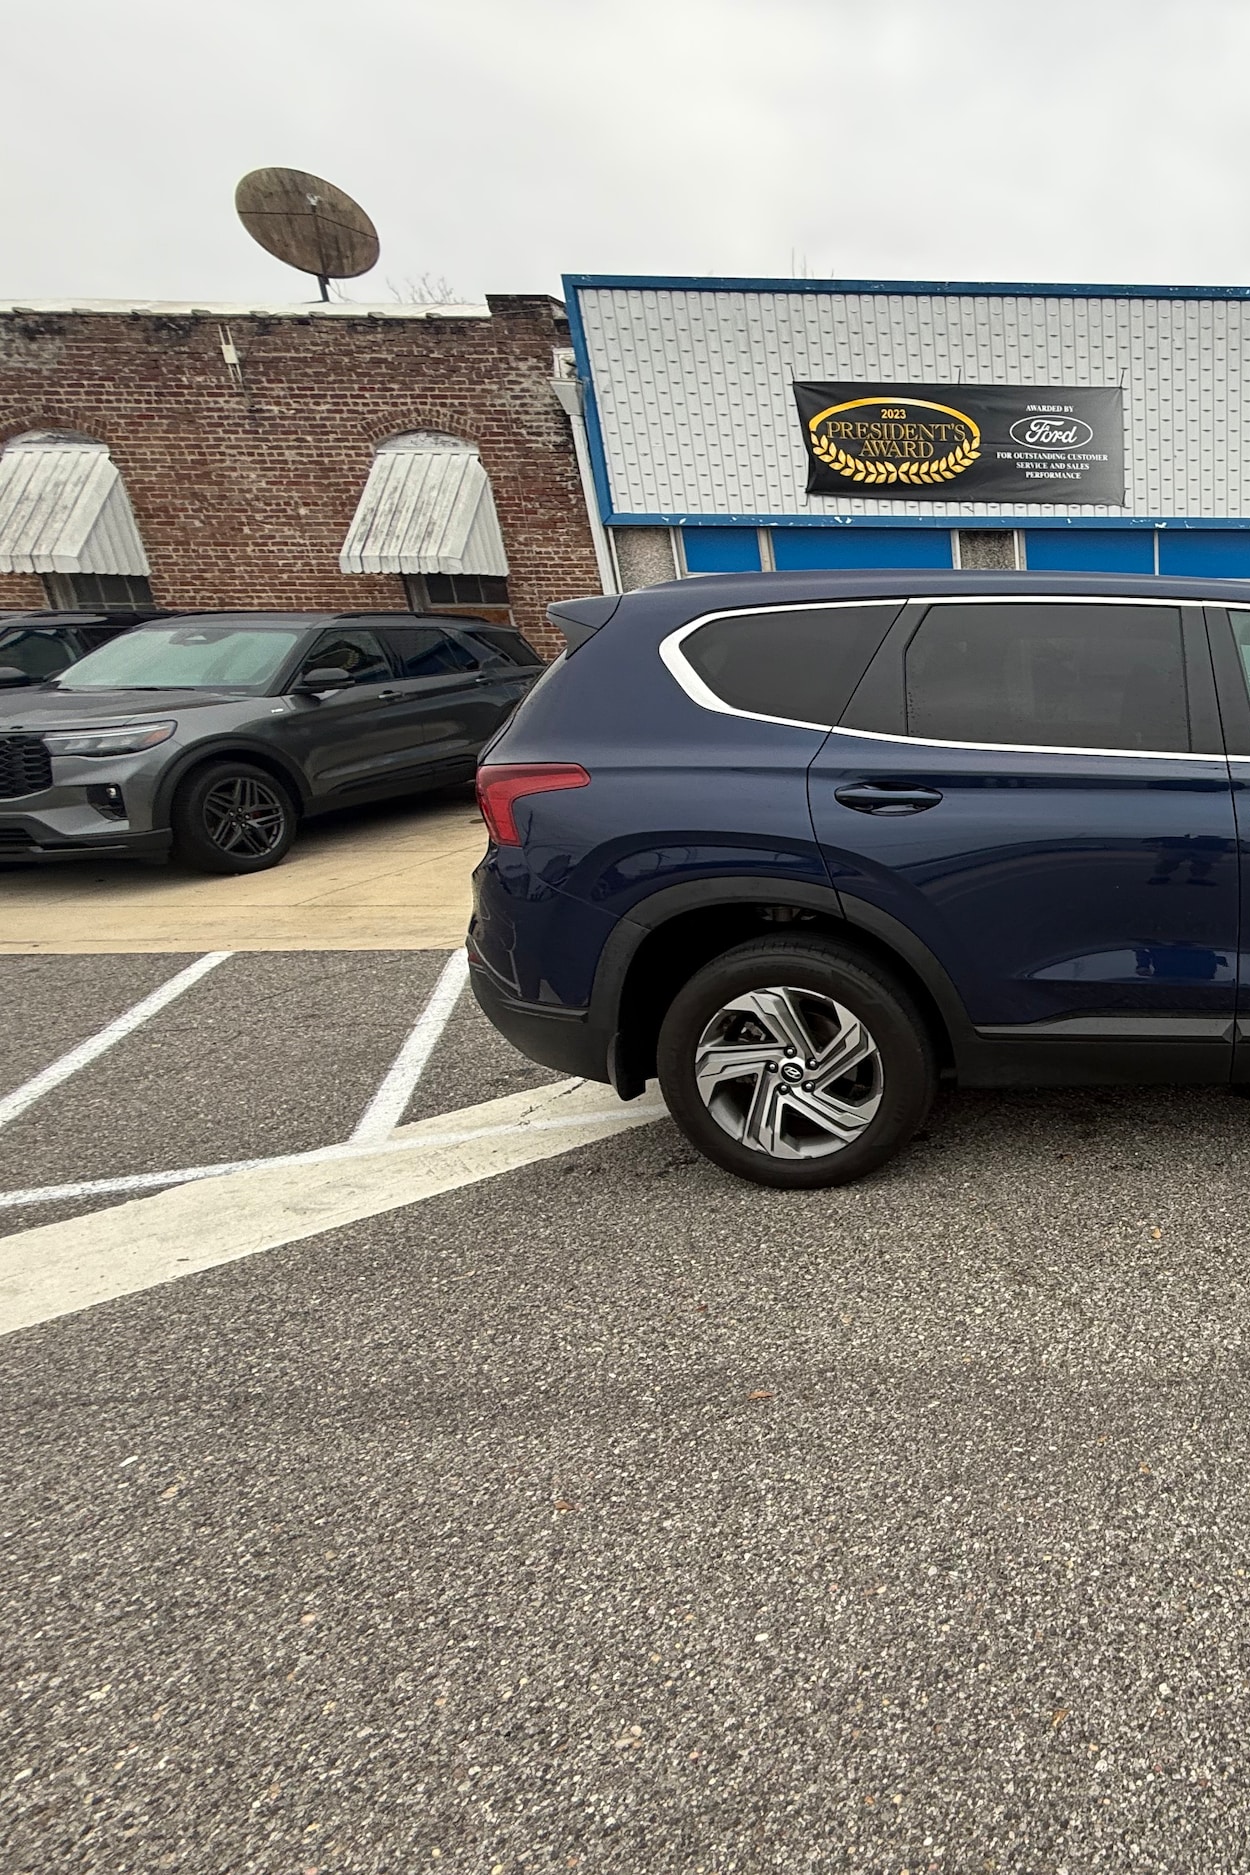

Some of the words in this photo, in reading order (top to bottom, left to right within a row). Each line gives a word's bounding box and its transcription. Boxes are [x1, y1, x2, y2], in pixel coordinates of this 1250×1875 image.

[880, 409, 907, 419] 2023
[826, 421, 966, 442] PRESIDENT'S
[1025, 419, 1078, 443] Ford
[858, 440, 934, 458] AWARD
[1014, 452, 1066, 460] OUTSTANDING
[1067, 453, 1108, 461] CUSTOMER
[1026, 471, 1081, 479] PERFORMANCE
